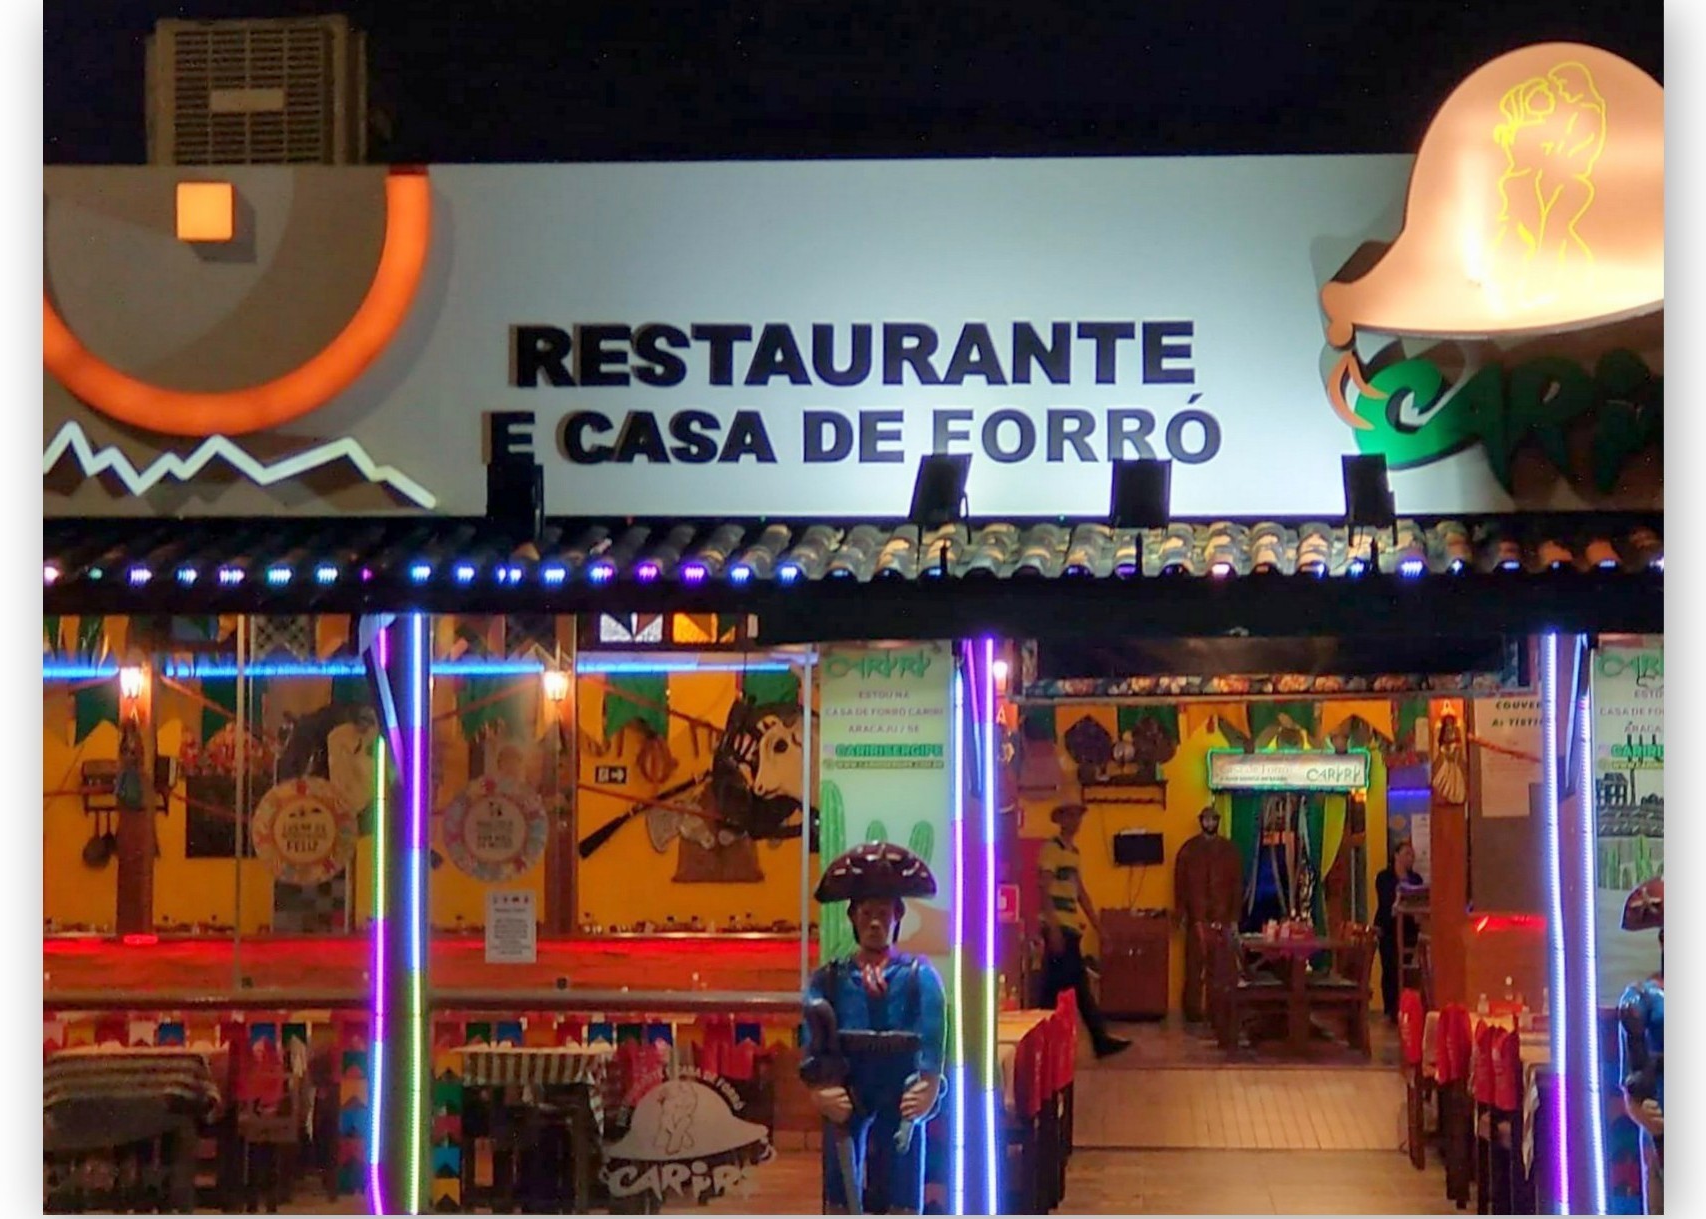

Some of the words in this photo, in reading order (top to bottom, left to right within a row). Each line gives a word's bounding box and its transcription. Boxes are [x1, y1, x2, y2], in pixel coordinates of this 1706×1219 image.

[509, 321, 1196, 387] RESTAURANTE
[483, 410, 535, 465] E
[555, 410, 778, 465] CASA
[803, 410, 905, 463] DE
[932, 392, 1222, 465] FORRÓ
